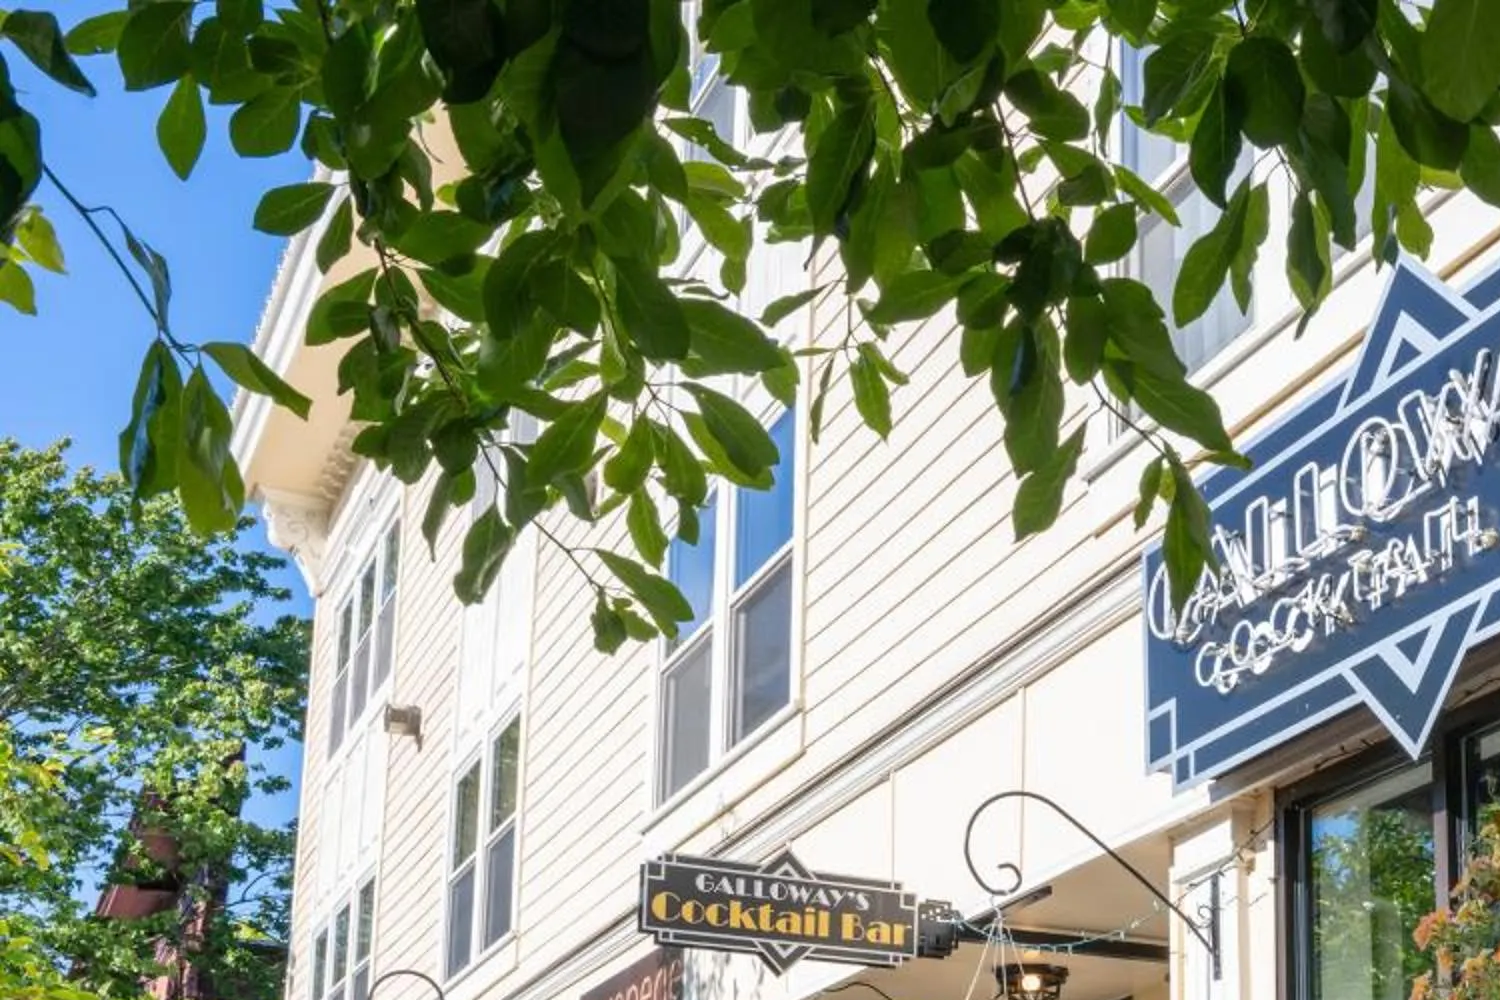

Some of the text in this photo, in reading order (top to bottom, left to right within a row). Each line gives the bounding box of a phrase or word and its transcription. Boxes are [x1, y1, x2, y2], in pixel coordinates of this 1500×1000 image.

[694, 872, 872, 912] GALLOWAY'S
[651, 891, 913, 946] Cocktail Bar
